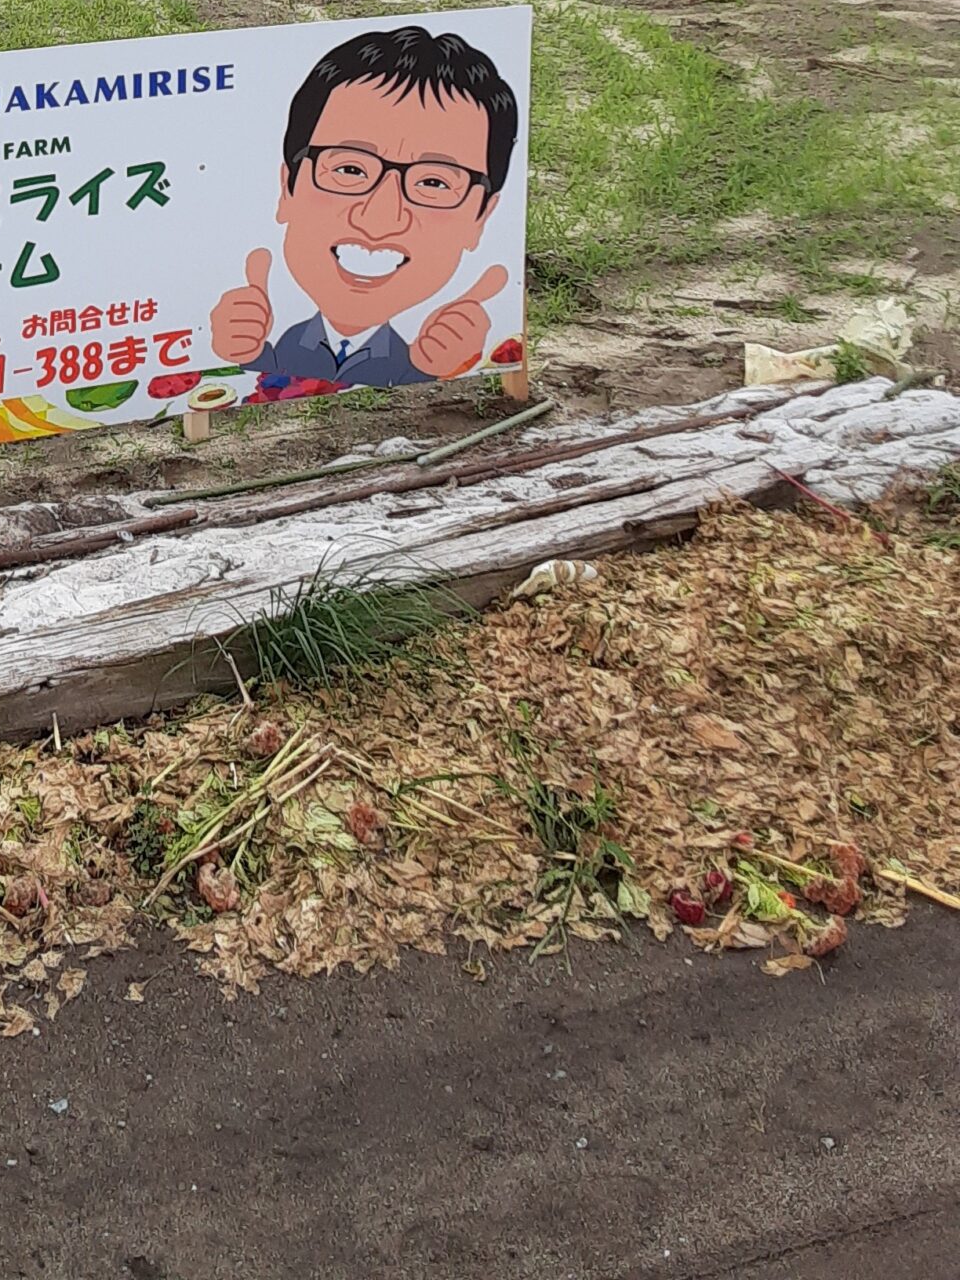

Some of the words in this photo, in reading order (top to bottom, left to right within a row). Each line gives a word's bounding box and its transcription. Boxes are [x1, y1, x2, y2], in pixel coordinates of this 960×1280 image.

[4, 136, 72, 160] FARM
[22, 298, 158, 339] お問合せは
